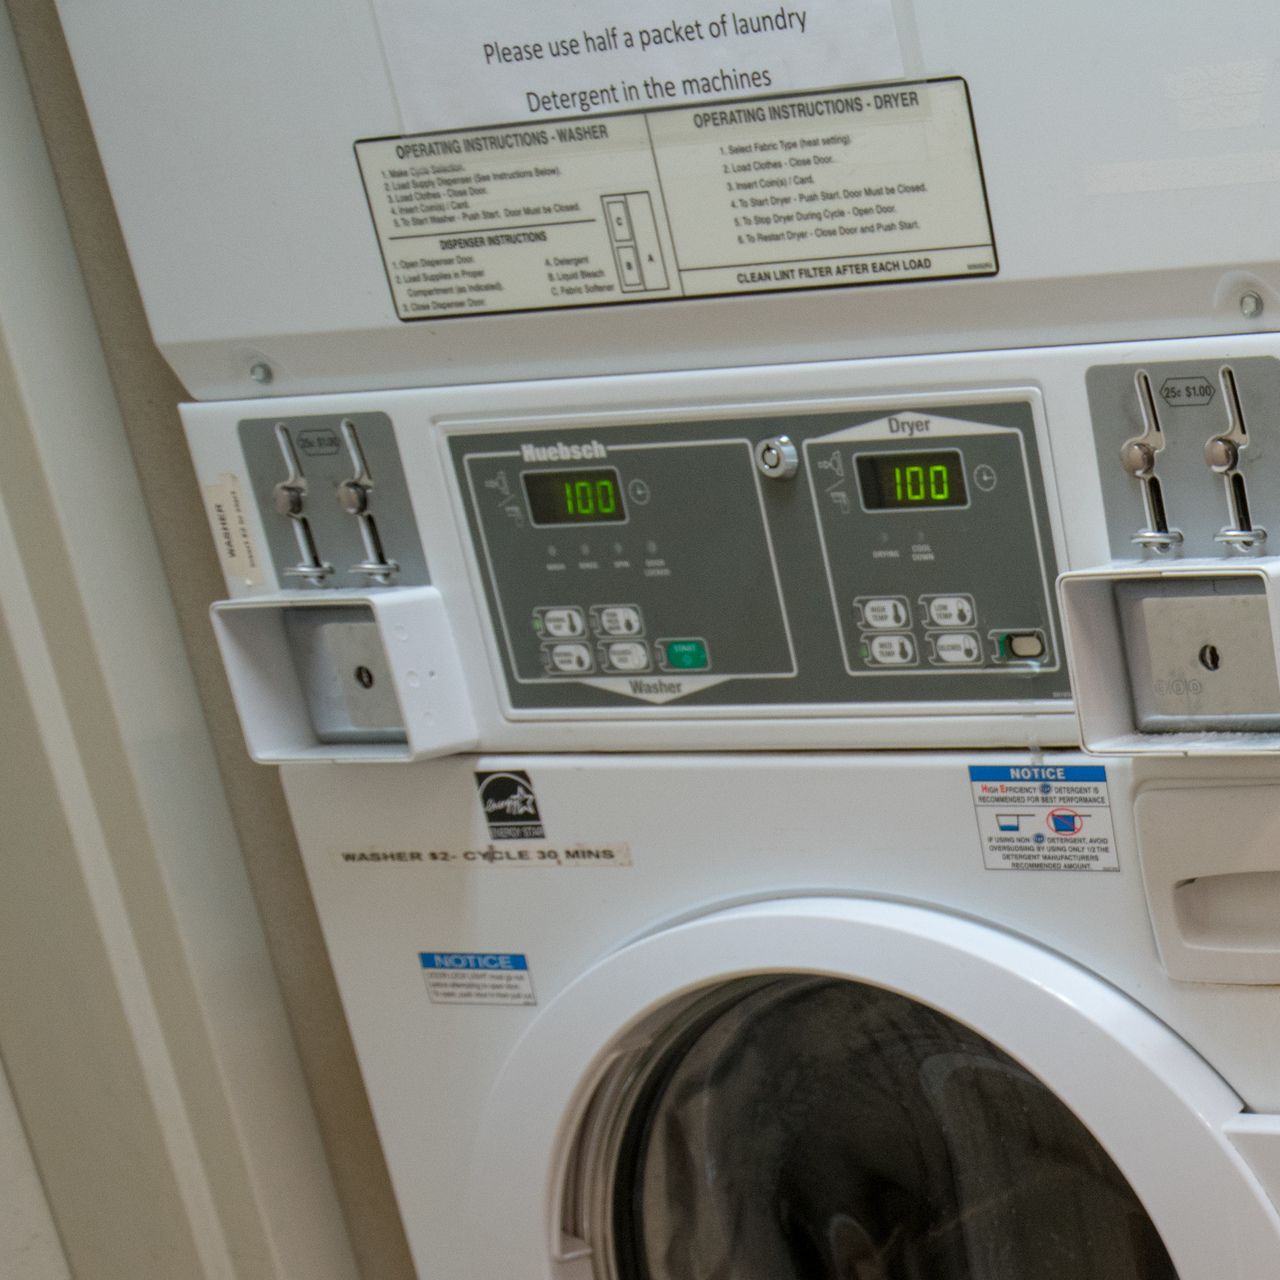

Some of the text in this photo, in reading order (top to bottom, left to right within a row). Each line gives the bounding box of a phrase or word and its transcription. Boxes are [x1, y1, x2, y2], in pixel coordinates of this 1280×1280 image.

[483, 6, 807, 65] Please use half a packet of laundry
[525, 68, 772, 113] Detergent in the machines
[693, 106, 767, 129] OPERATING
[768, 97, 863, 121] INSTRUCTIONS
[873, 91, 919, 110] DRYER
[395, 138, 463, 160] OPERATING
[462, 130, 549, 153] INSTRUCTIONS
[556, 124, 609, 143] WASHER
[736, 257, 932, 284] CLEAN LINT FILTER AFTER EACH LOAD
[888, 416, 931, 436] Dryer
[521, 440, 607, 462] Huebsch
[895, 465, 949, 500] 100
[565, 479, 615, 515] 100
[628, 680, 682, 695] Washer
[1009, 767, 1066, 780] NOTICE
[342, 851, 422, 862] WASHER
[463, 850, 530, 861] CYCLE
[537, 850, 559, 860] 30
[565, 849, 615, 859] MINS
[435, 955, 513, 969] NOTICE
